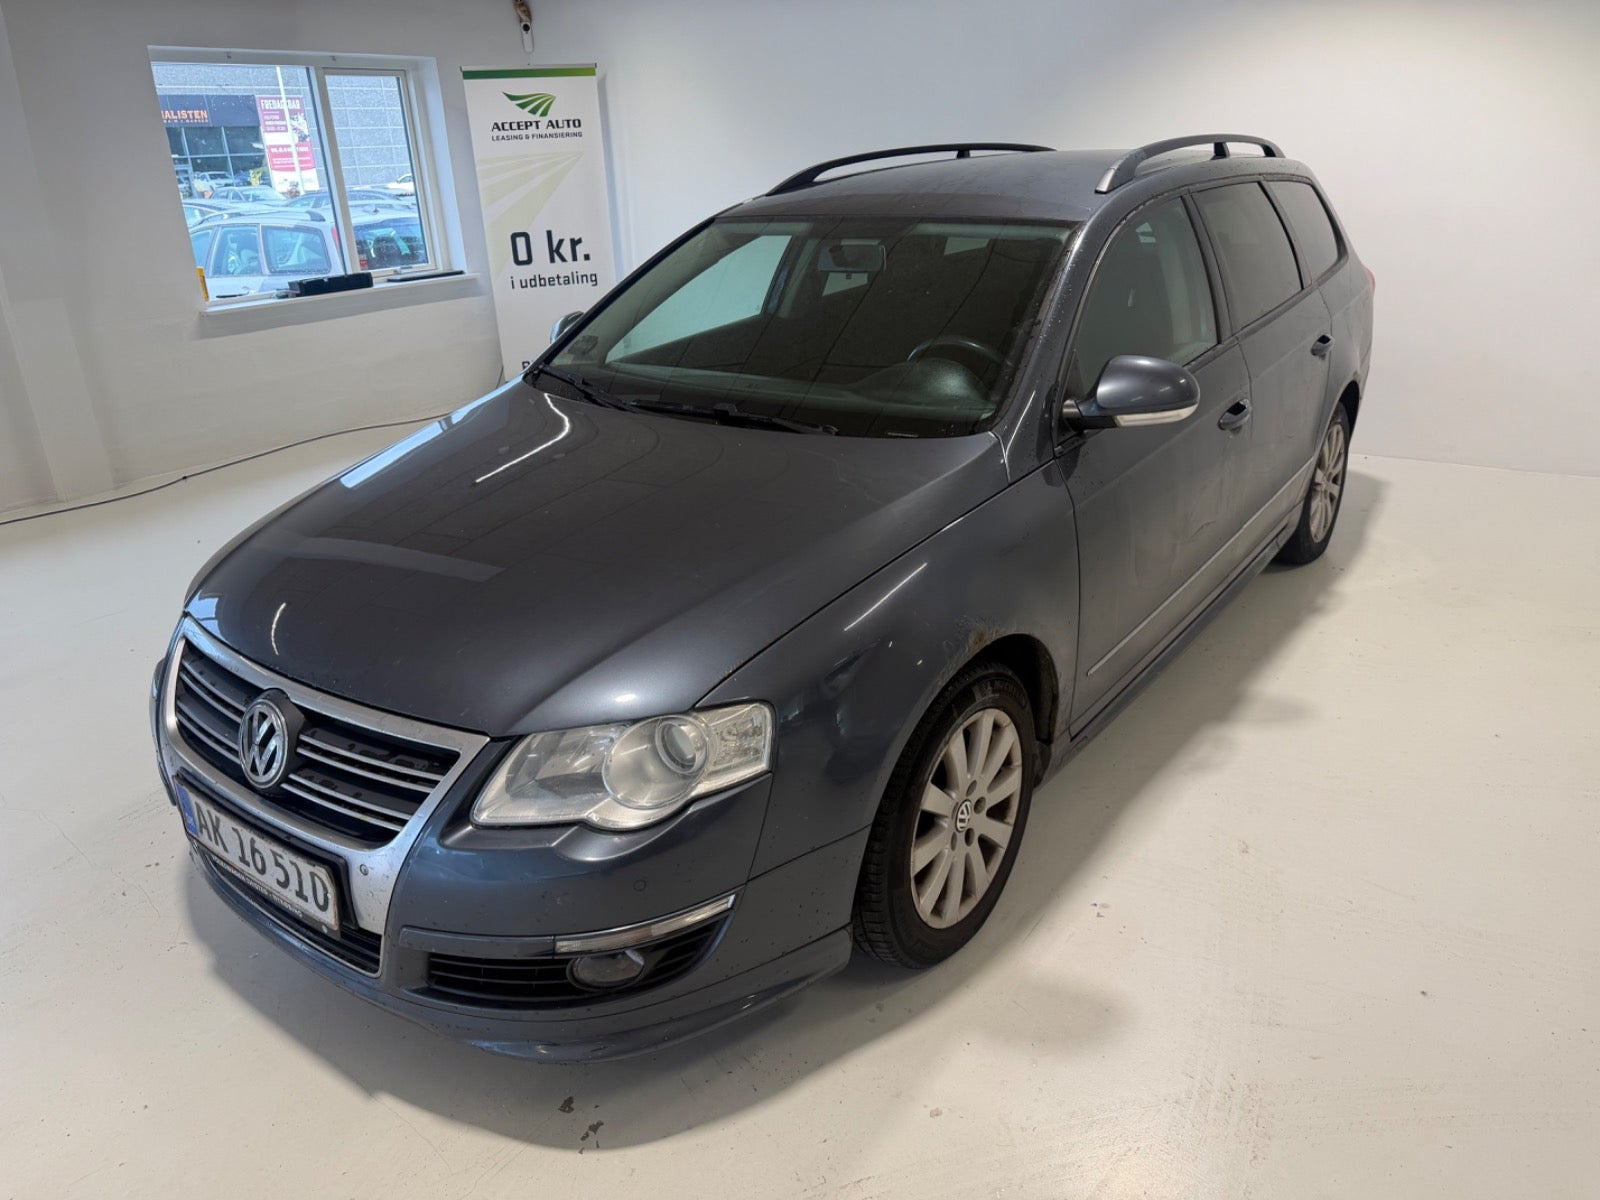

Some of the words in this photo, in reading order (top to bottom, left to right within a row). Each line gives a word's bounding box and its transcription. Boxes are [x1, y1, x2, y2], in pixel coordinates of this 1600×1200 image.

[491, 120, 541, 132] ACCEPT
[546, 118, 582, 130] AUTO
[491, 133, 524, 142] LEASING
[532, 131, 583, 140] FINANSIERING
[510, 231, 534, 267] 0
[546, 229, 591, 264] kr.
[510, 275, 515, 290] i
[520, 271, 598, 289] udbetaling
[194, 800, 229, 854] AK
[231, 826, 267, 876] 16
[269, 848, 330, 913] 510
